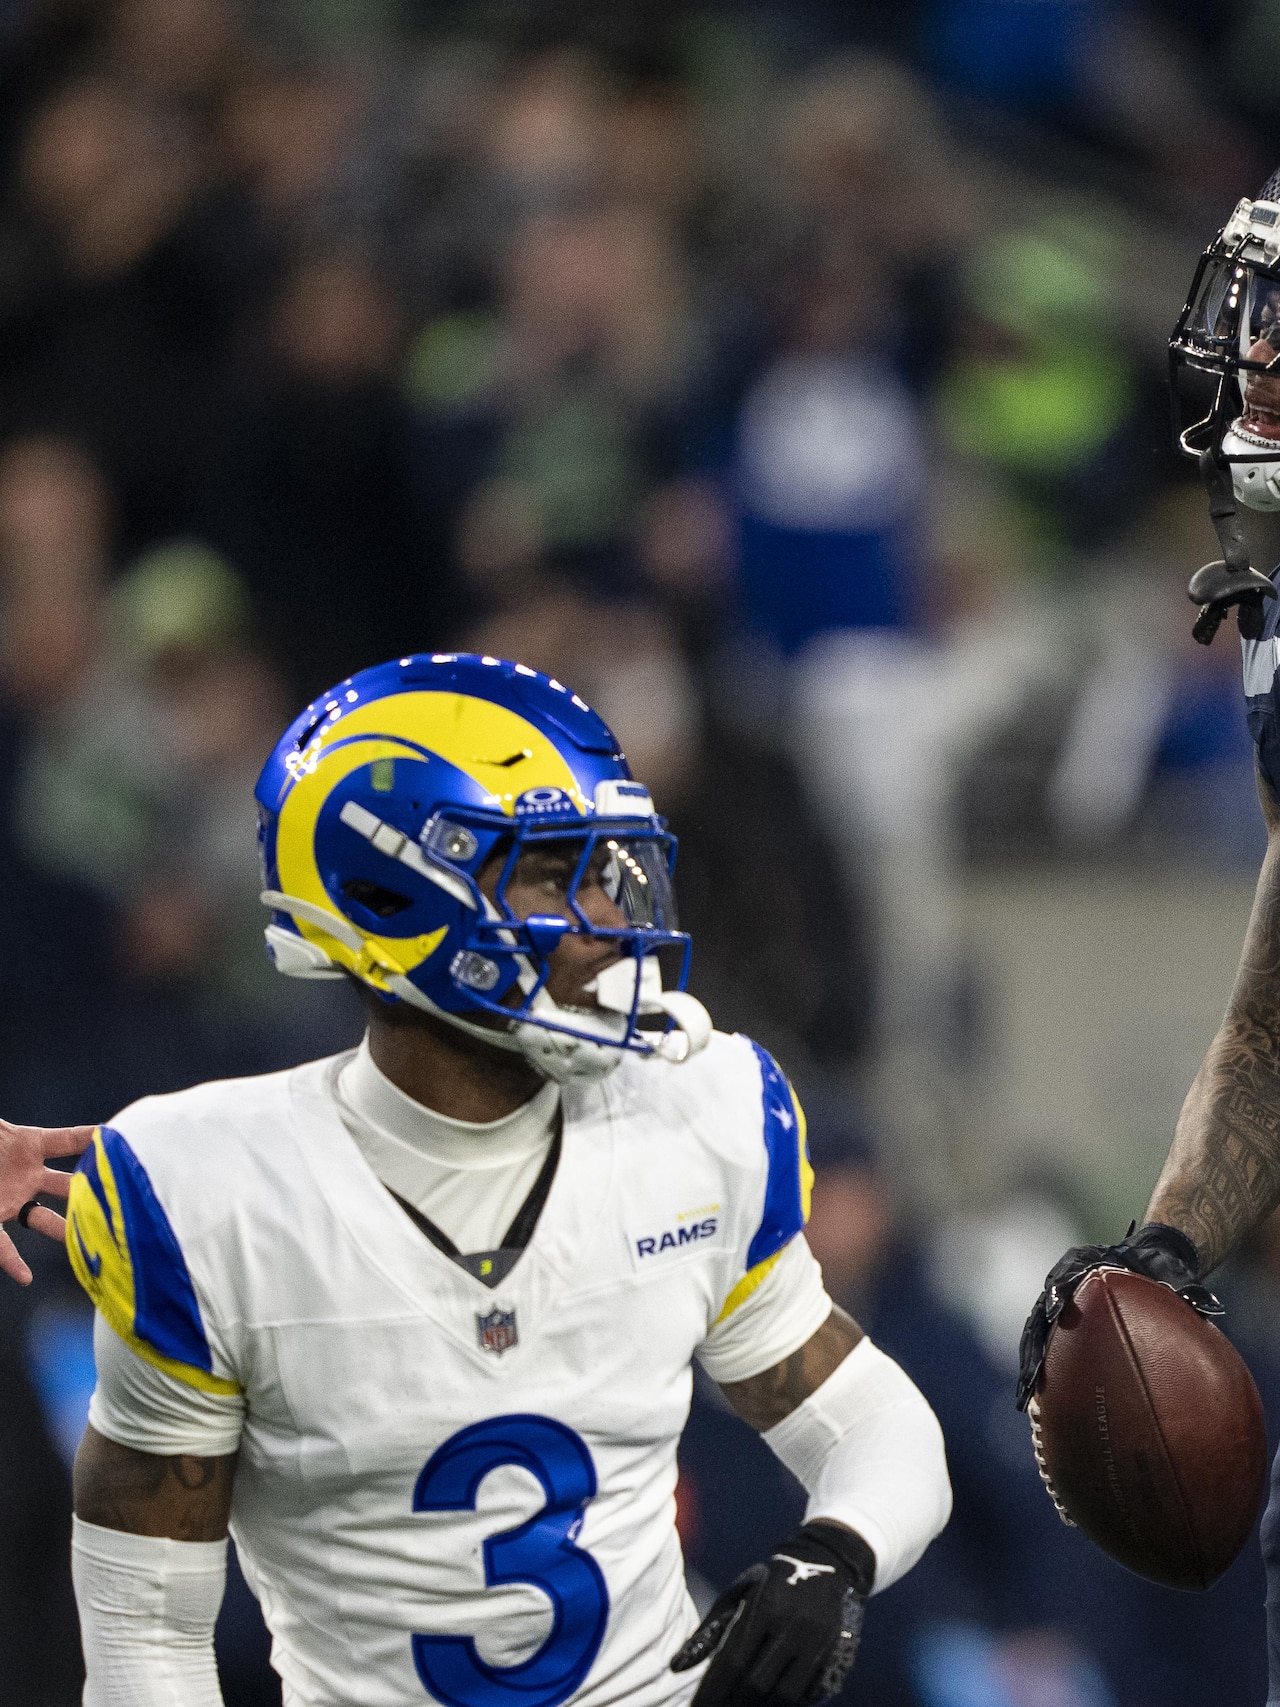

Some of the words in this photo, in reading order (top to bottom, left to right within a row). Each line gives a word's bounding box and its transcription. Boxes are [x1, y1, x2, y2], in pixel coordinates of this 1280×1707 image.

[636, 1218, 717, 1257] RAMS
[1095, 1384, 1110, 1441] LEAGUE
[411, 1413, 611, 1707] 3
